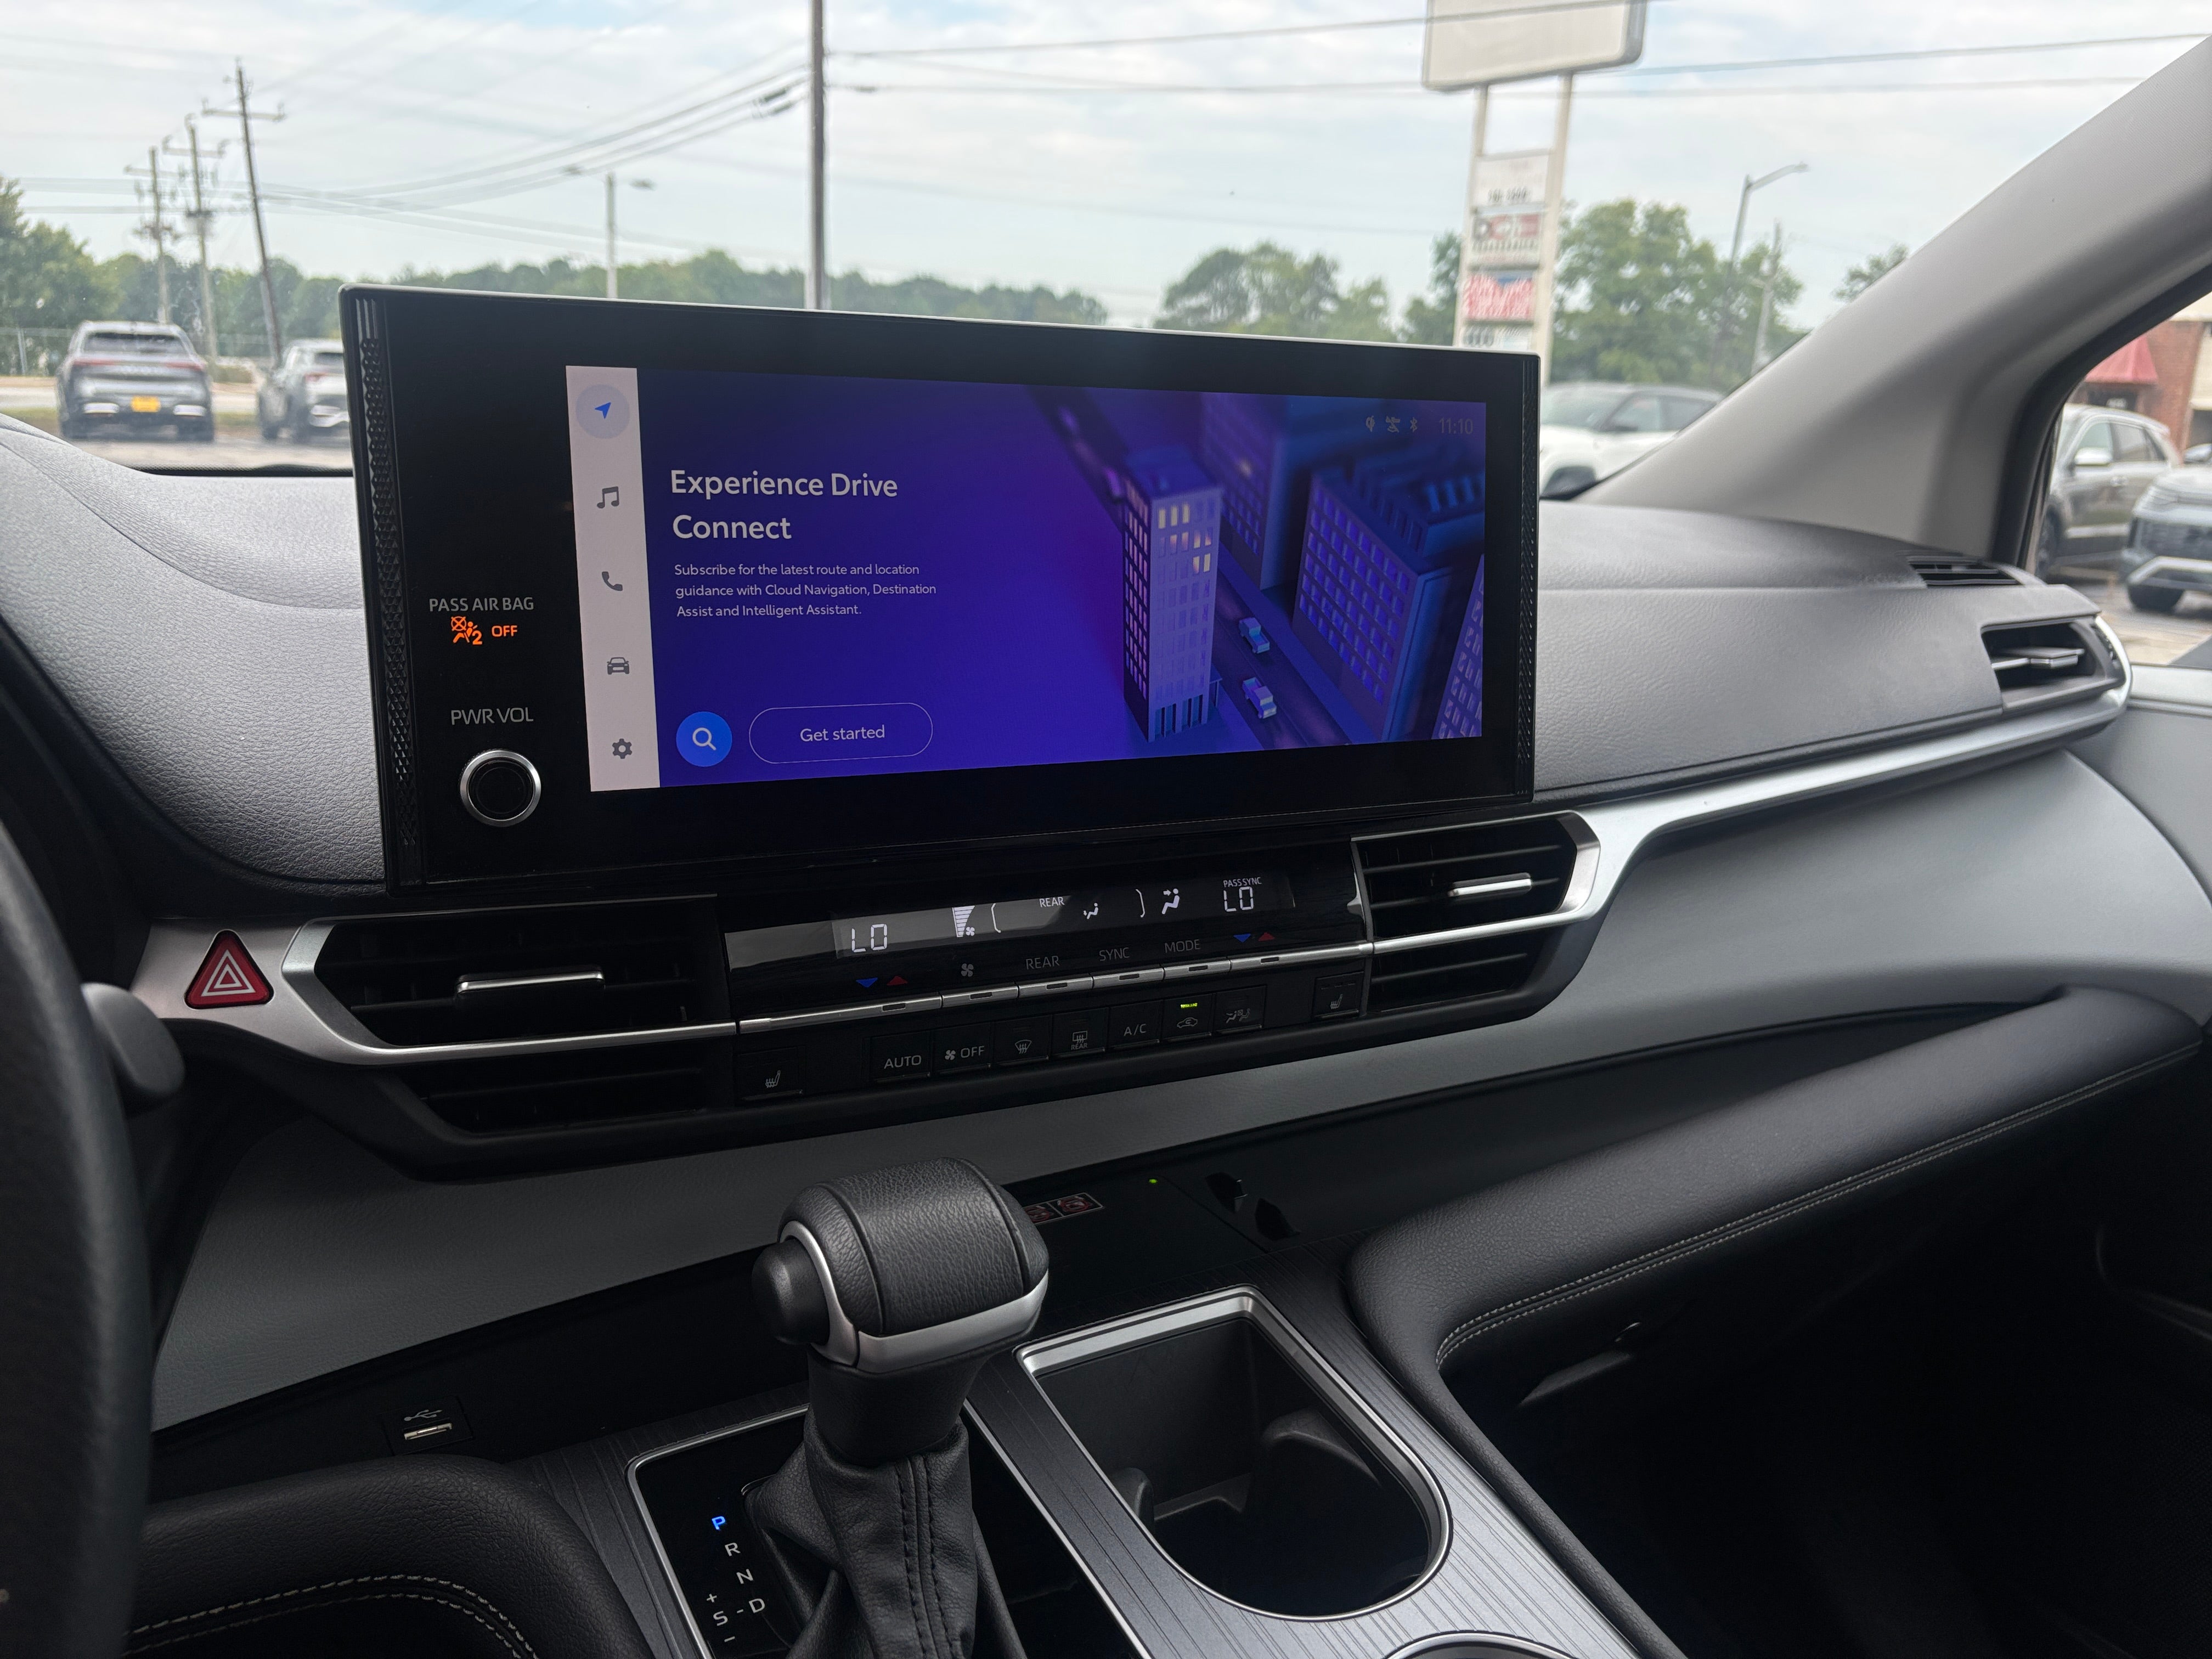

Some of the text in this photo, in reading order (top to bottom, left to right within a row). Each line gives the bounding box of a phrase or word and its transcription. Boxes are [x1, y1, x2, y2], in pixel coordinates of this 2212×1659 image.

[1440, 417, 1474, 435] 11:10
[672, 470, 898, 499] Experience Drive
[673, 515, 792, 539] Connect
[675, 564, 919, 575] Subscribe for the latest route and location
[676, 584, 936, 599] guidance with Cloud Navigation, Destination
[430, 597, 533, 611] PASS AIR BAG
[677, 605, 861, 618] Assist and Intelligent Assistant.
[492, 625, 517, 636] OFF
[452, 707, 534, 725] PWR VOL
[800, 725, 884, 742] Get started
[1242, 877, 1262, 886] SYNC
[1039, 897, 1065, 908] REAR
[1223, 887, 1254, 912] LO
[852, 924, 887, 952] LO
[1165, 939, 1200, 953] MODE
[1099, 947, 1130, 961] SYNC
[1026, 956, 1060, 970] REAR
[1124, 1024, 1146, 1036] A/C
[961, 1046, 984, 1058] OFF
[884, 1055, 921, 1069] AUTO
[712, 1516, 725, 1530] P
[725, 1543, 740, 1556] R
[737, 1569, 753, 1584] N
[713, 1611, 727, 1626] S
[749, 1599, 765, 1613] D
